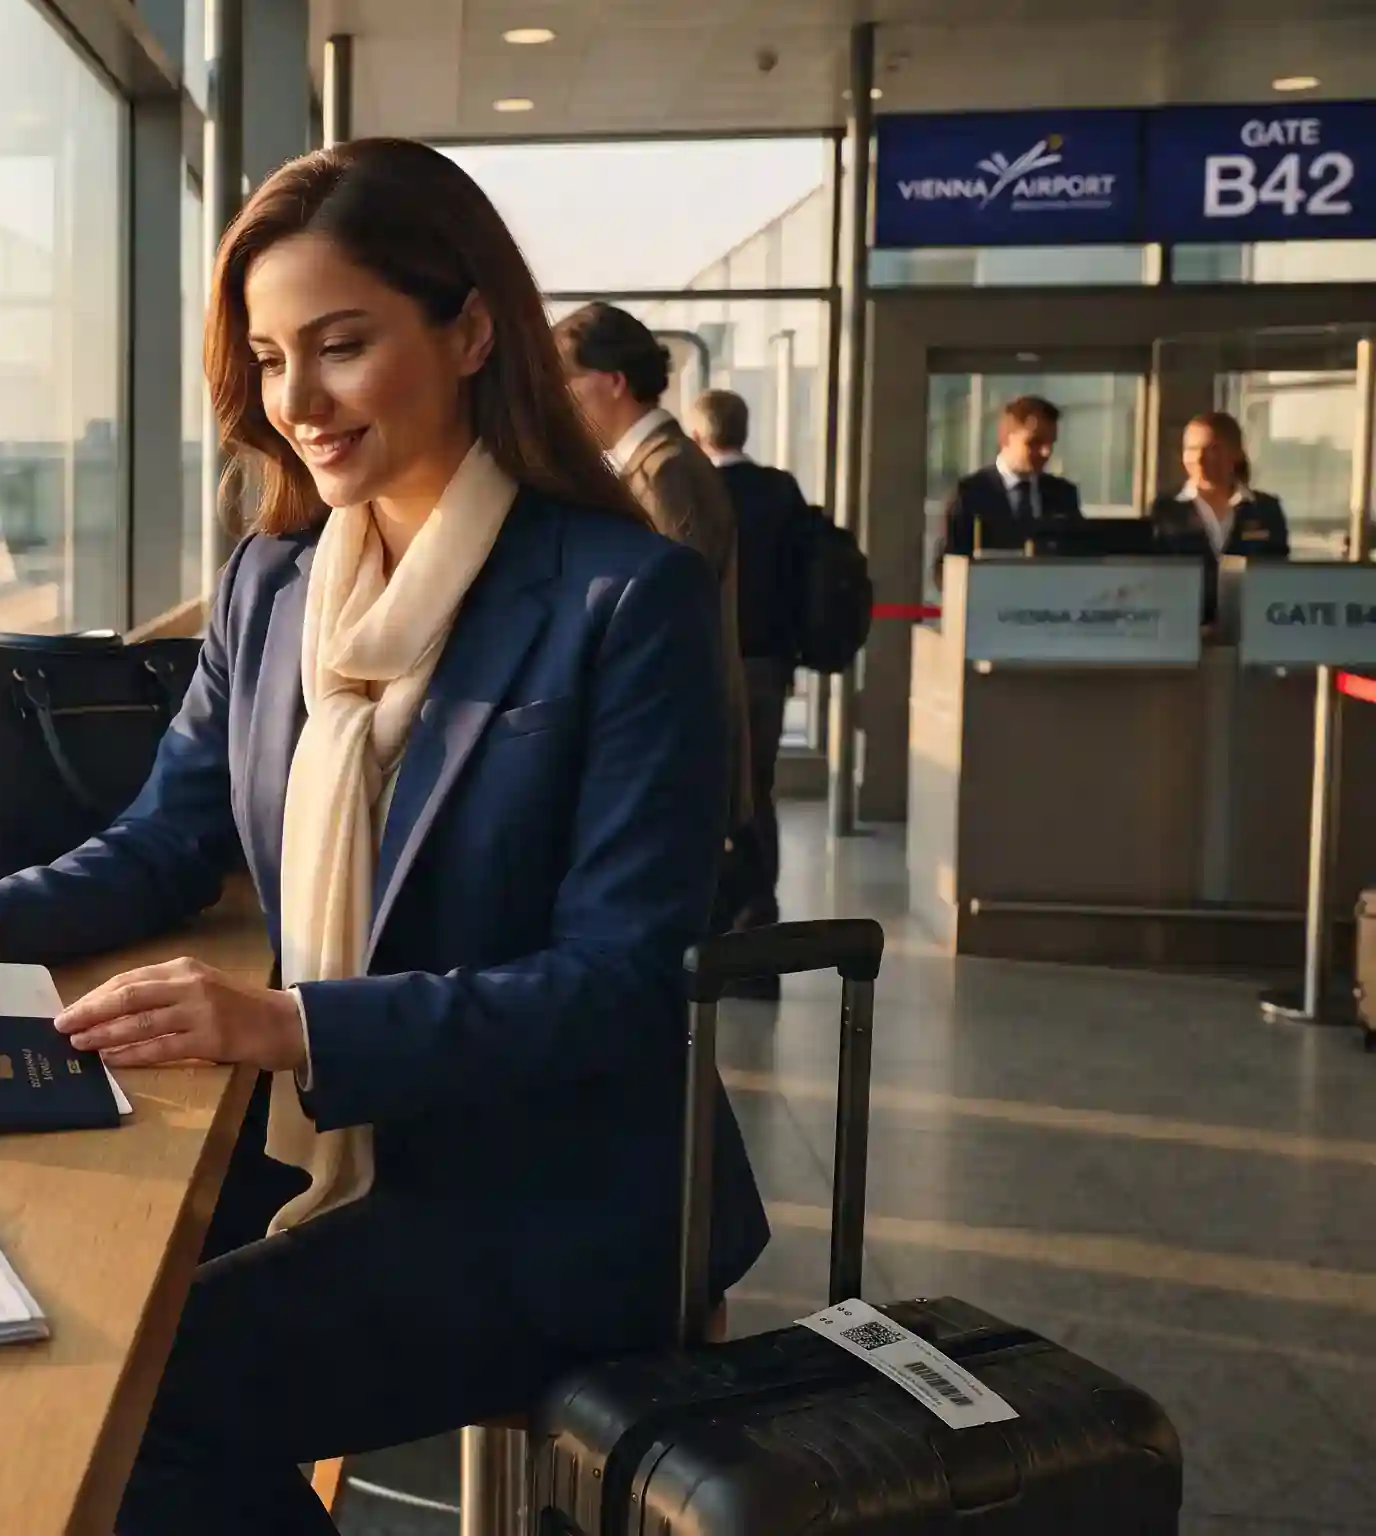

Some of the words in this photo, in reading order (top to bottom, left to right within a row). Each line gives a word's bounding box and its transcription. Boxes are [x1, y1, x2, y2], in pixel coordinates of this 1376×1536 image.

[1240, 119, 1320, 147] GATE
[897, 180, 988, 201] VIENNA
[1012, 175, 1116, 197] AIRPORT
[1202, 153, 1355, 217] B42
